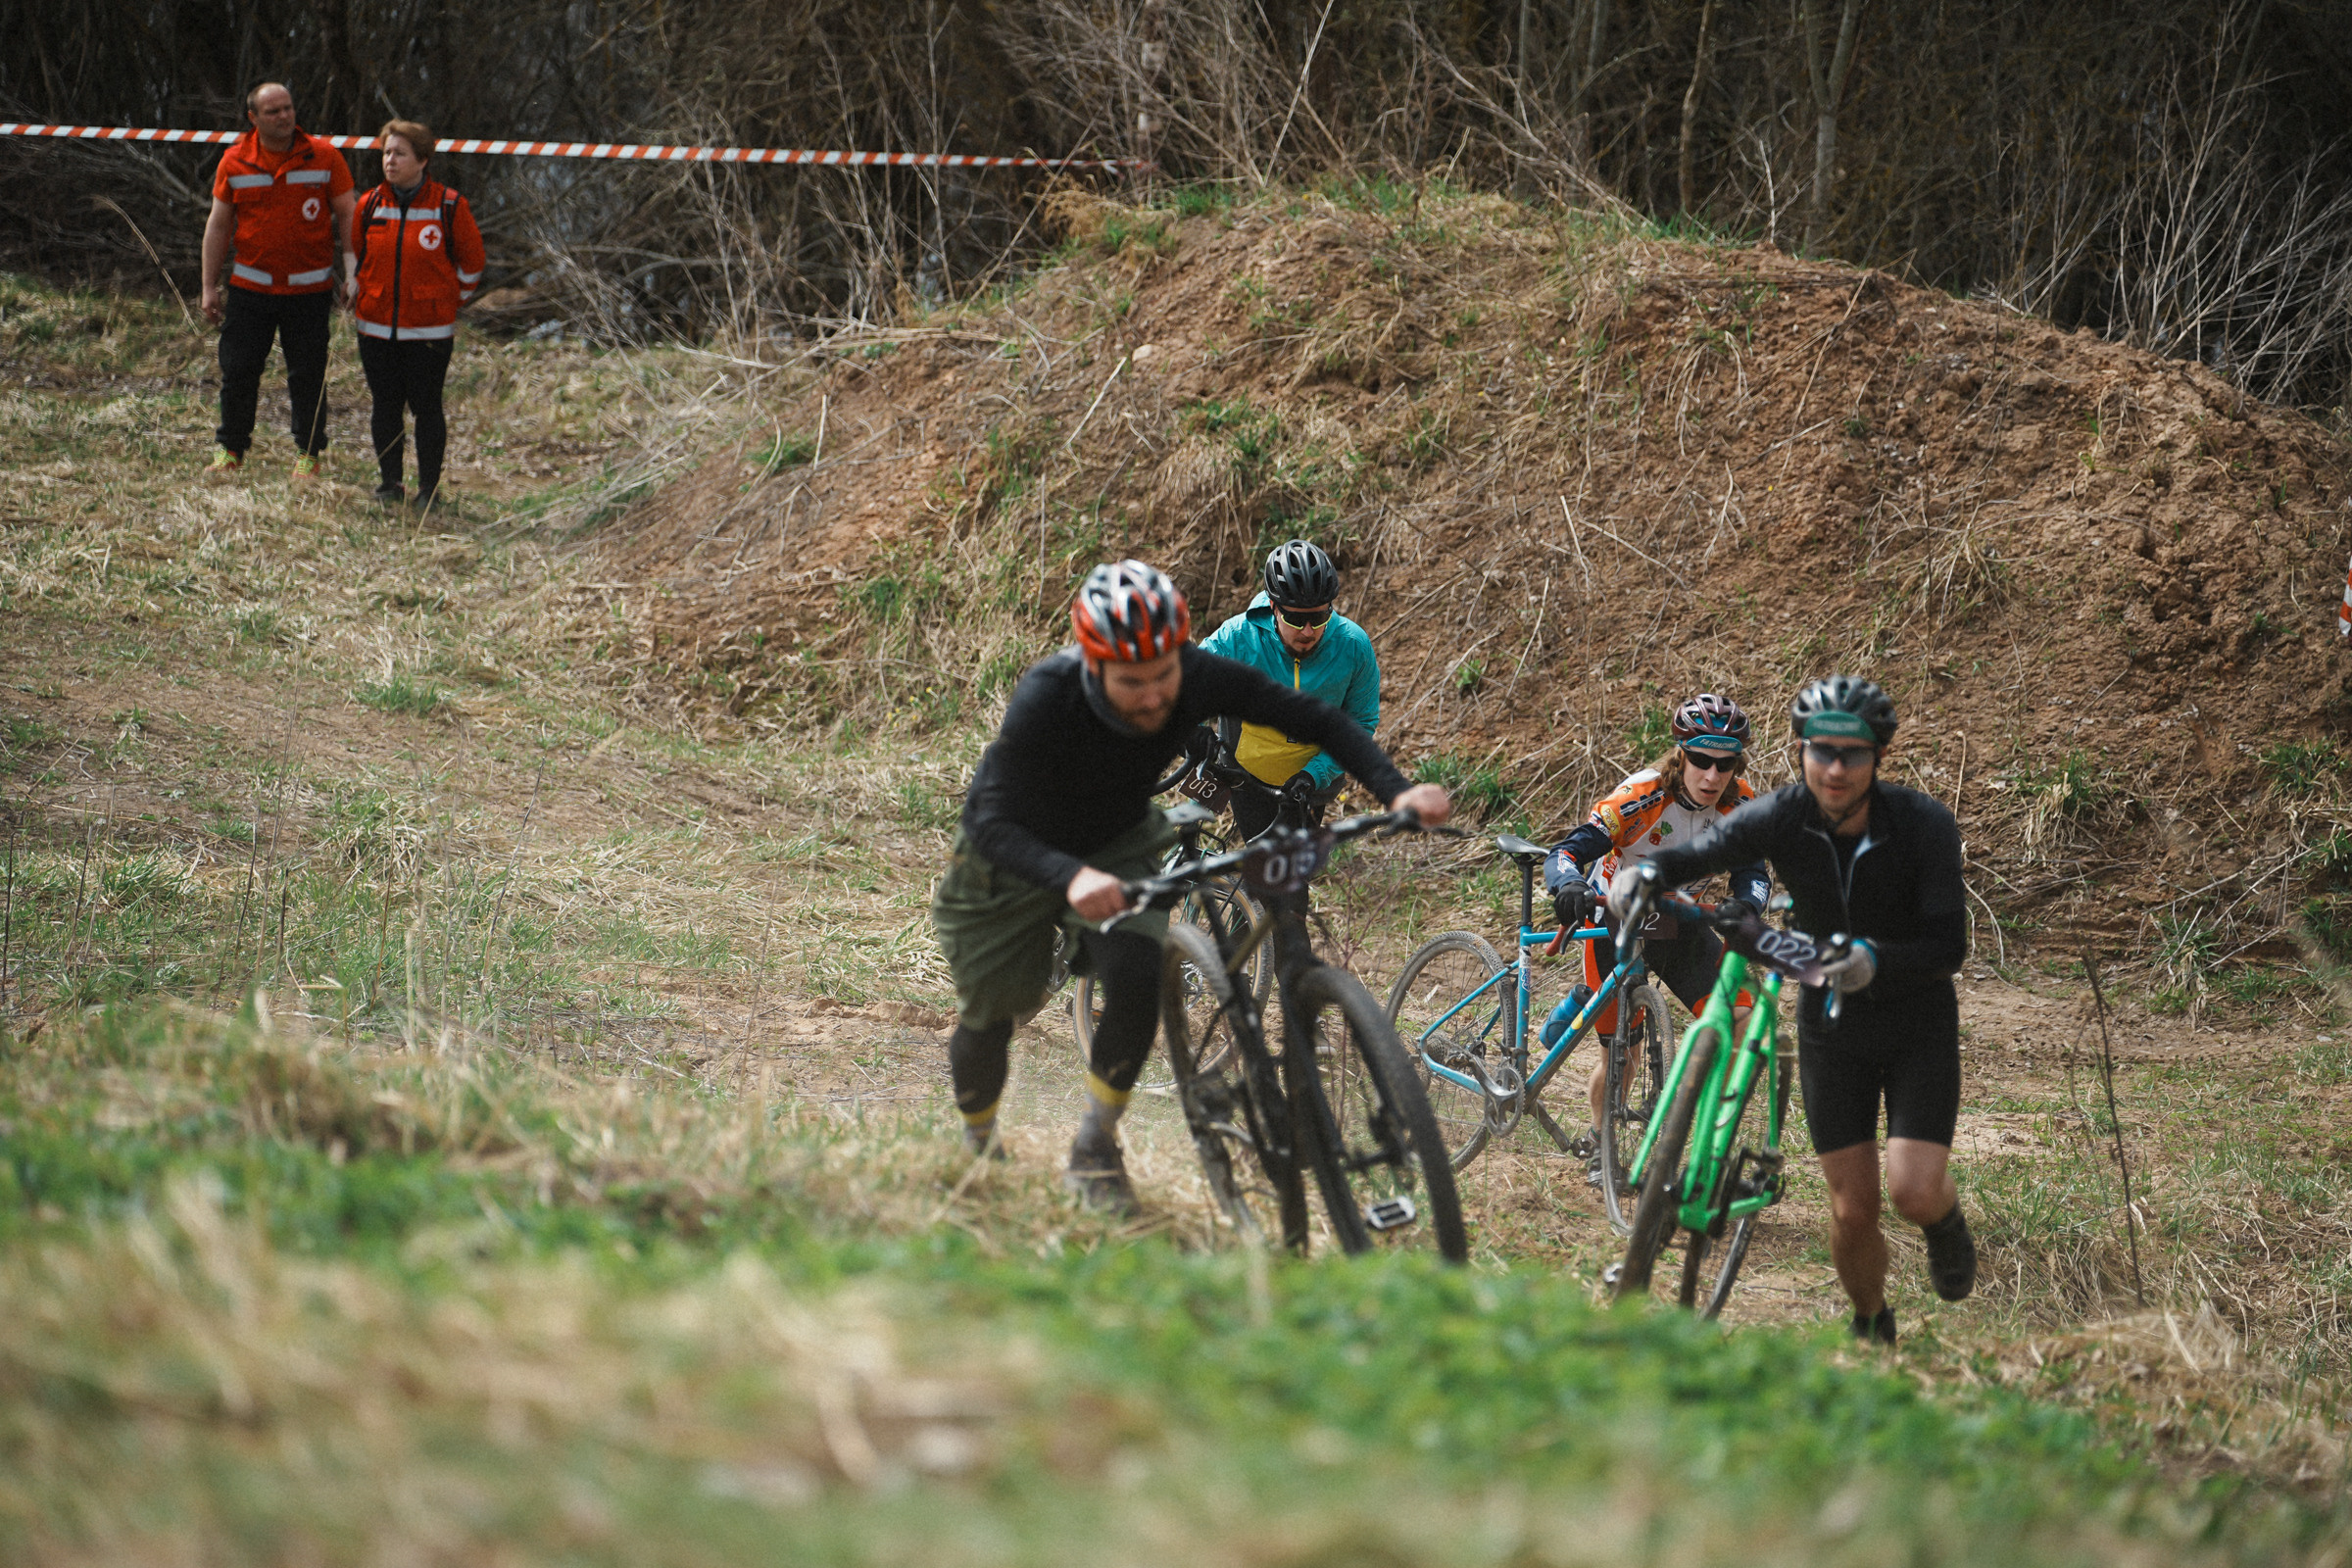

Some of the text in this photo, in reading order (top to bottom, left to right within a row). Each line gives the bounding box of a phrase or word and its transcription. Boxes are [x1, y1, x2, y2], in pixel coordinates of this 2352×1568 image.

[1699, 738, 1739, 749] FATRACING
[1189, 777, 1217, 799] 013
[1757, 931, 1817, 970] 022
